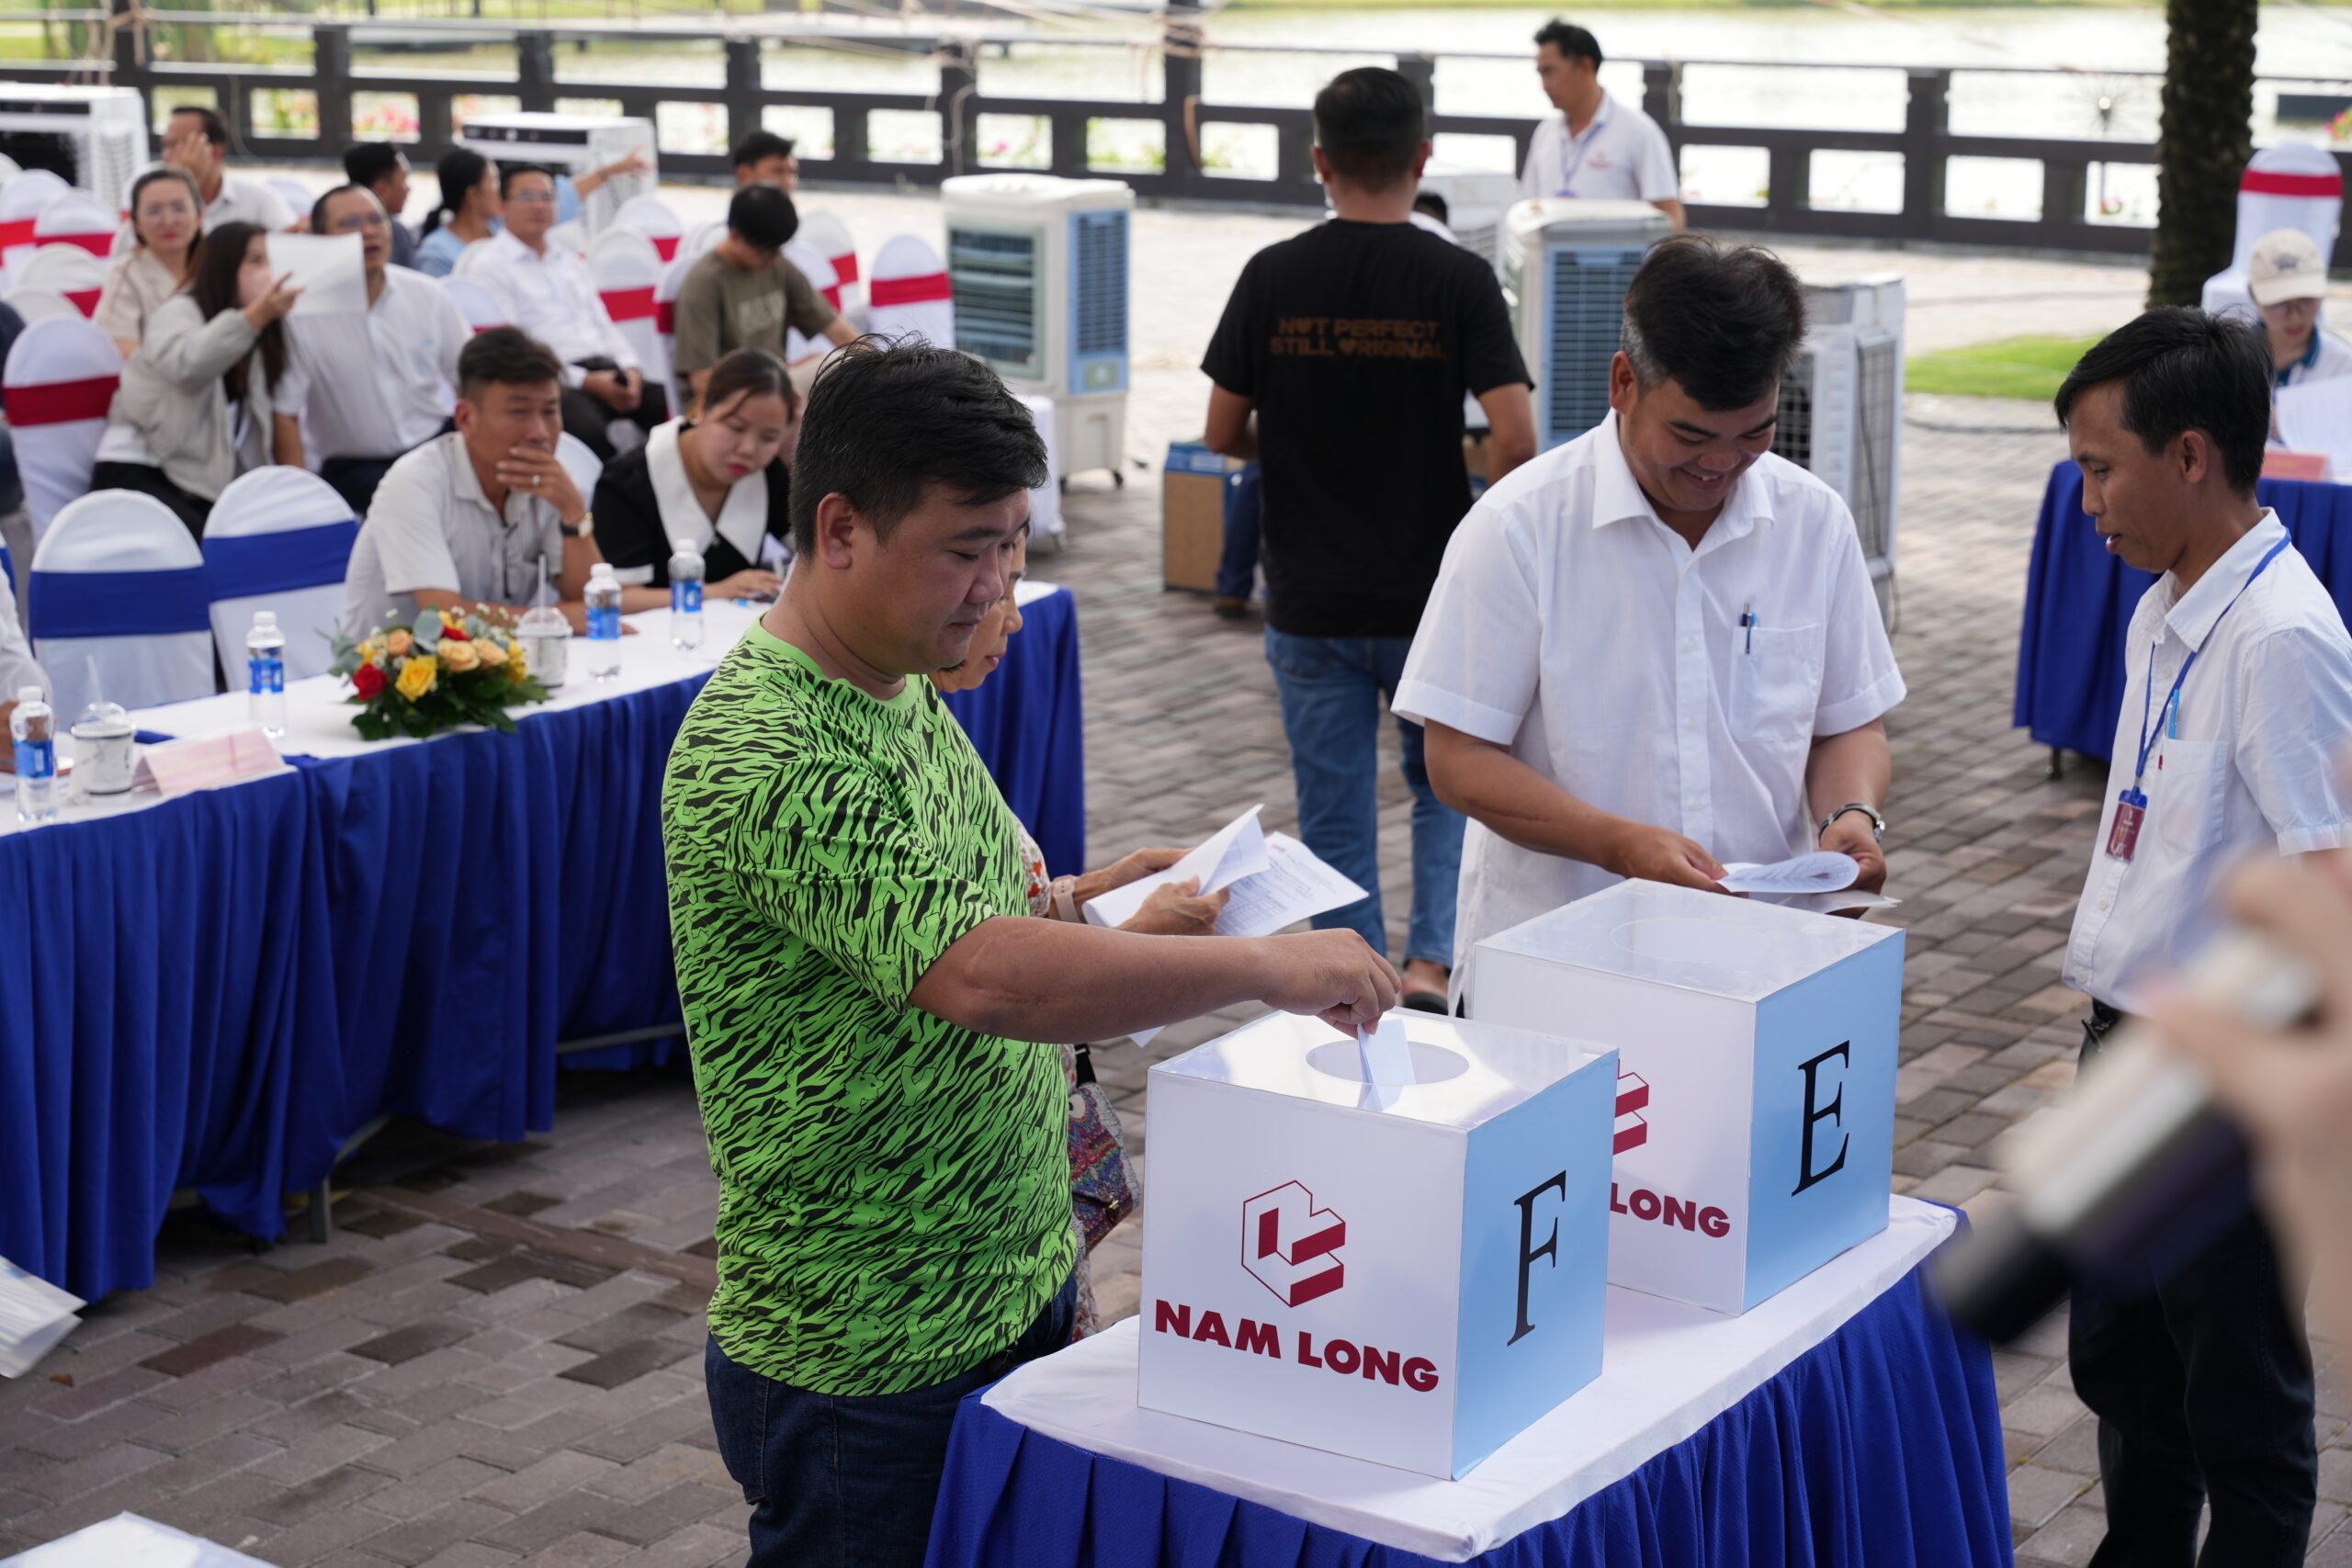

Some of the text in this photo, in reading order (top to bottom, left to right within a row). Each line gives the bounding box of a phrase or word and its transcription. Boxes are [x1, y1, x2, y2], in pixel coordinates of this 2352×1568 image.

[1270, 336, 1335, 356] STILL
[1332, 318, 1441, 338] PERFECT
[1792, 1040, 1850, 1197] E
[1610, 1181, 1730, 1238] LONG
[1507, 1170, 1566, 1347] F
[1155, 1299, 1439, 1393] NAM LONG
